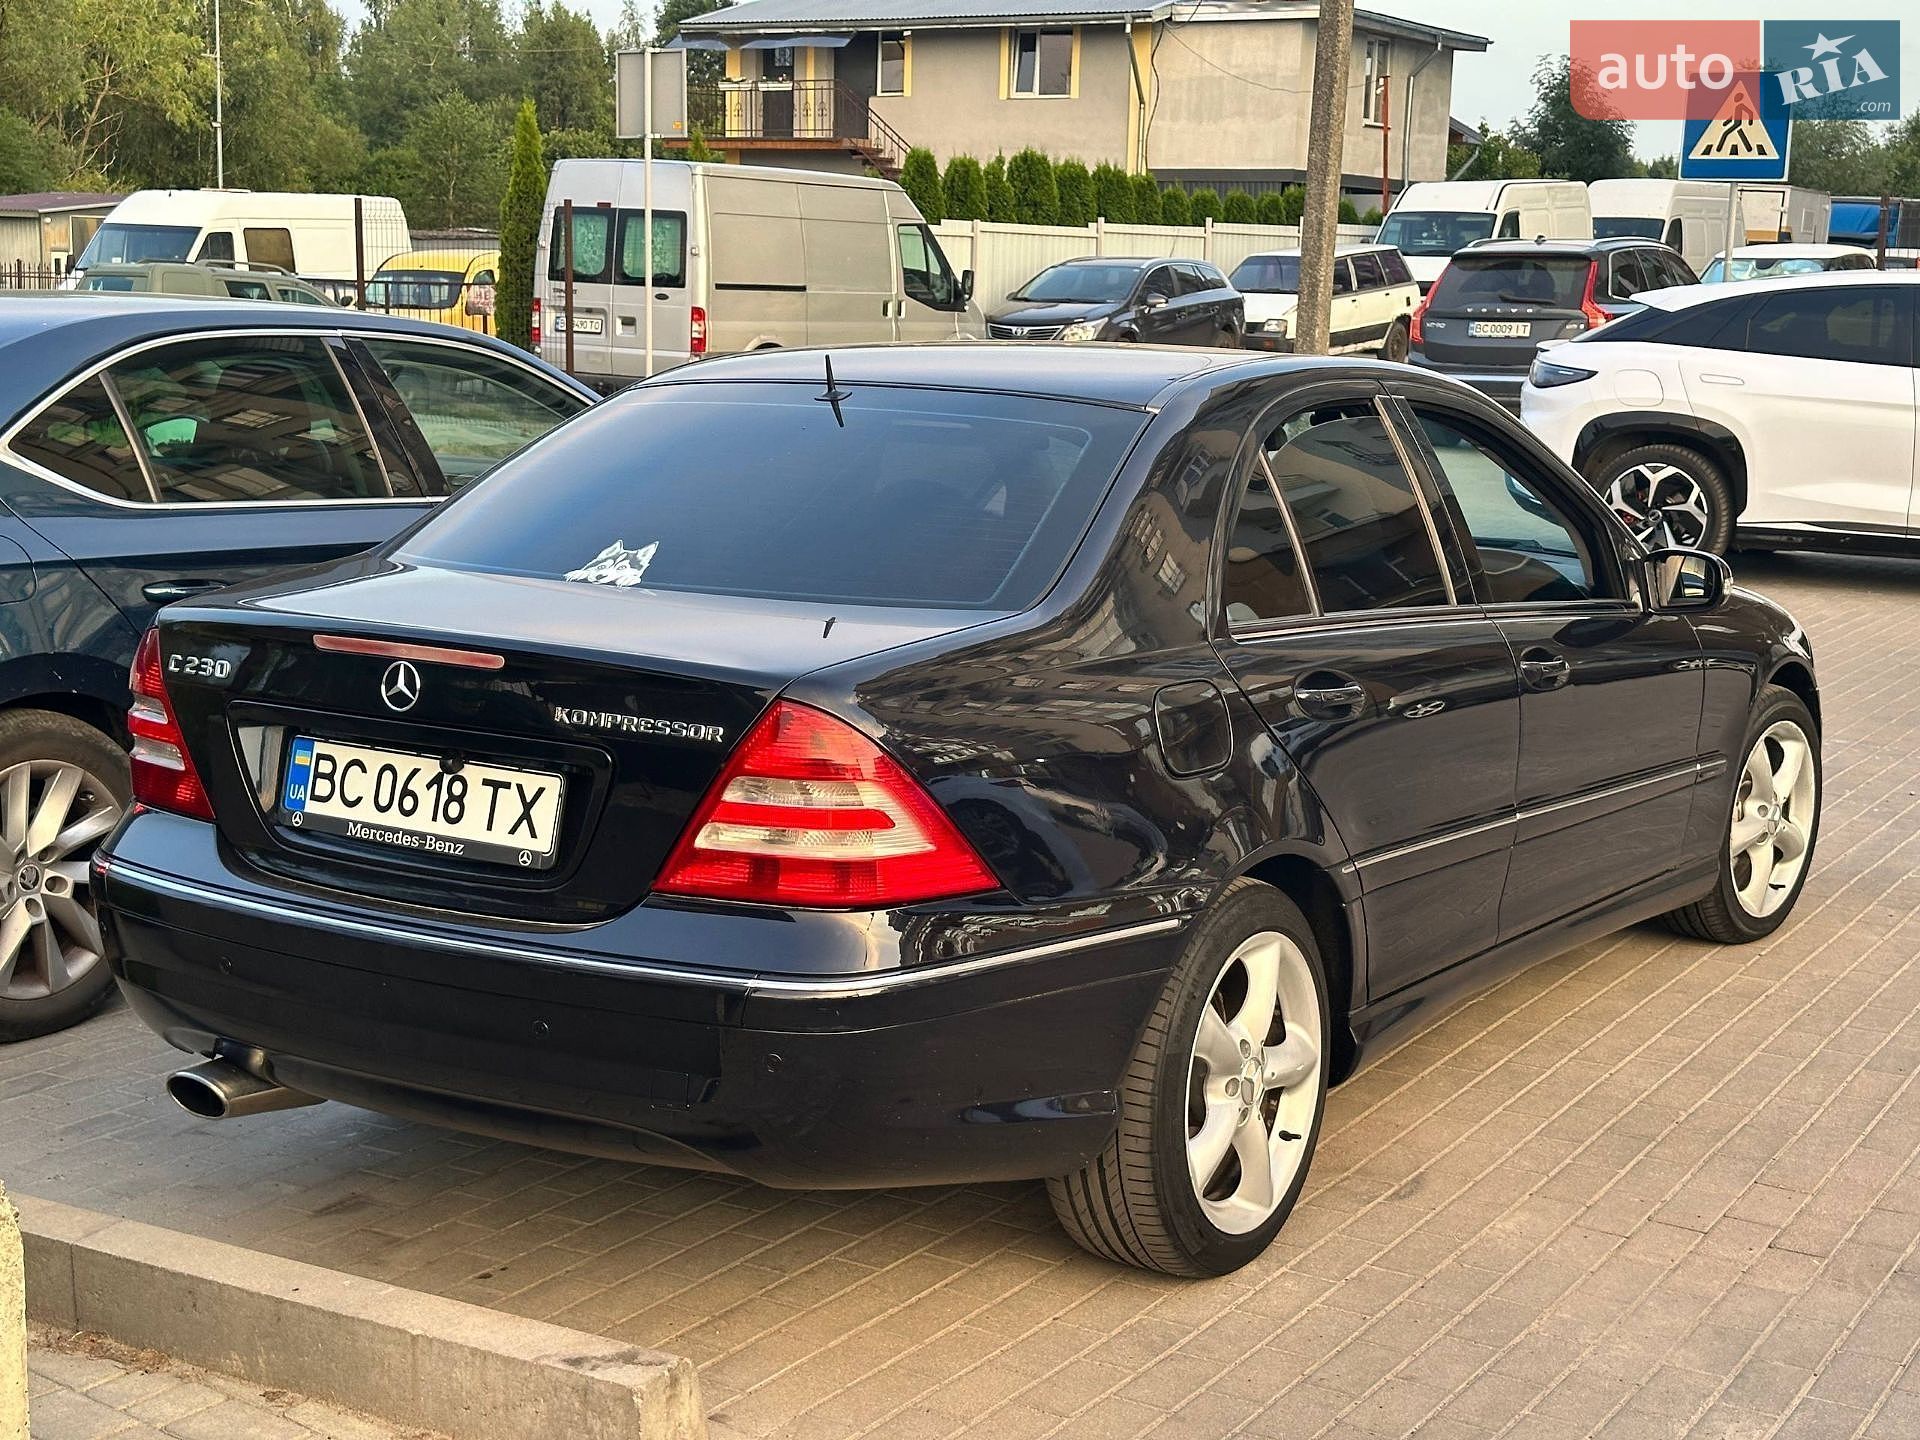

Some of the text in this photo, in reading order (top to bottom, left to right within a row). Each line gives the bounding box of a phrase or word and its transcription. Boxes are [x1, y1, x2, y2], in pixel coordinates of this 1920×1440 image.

[1475, 323, 1489, 334] BC
[1490, 323, 1513, 334] 0009
[554, 706, 724, 743] KOMPRESSOR
[289, 783, 306, 801] UA
[309, 752, 546, 840] BC 0618 TX
[346, 821, 465, 856] Mercedes-Benz
